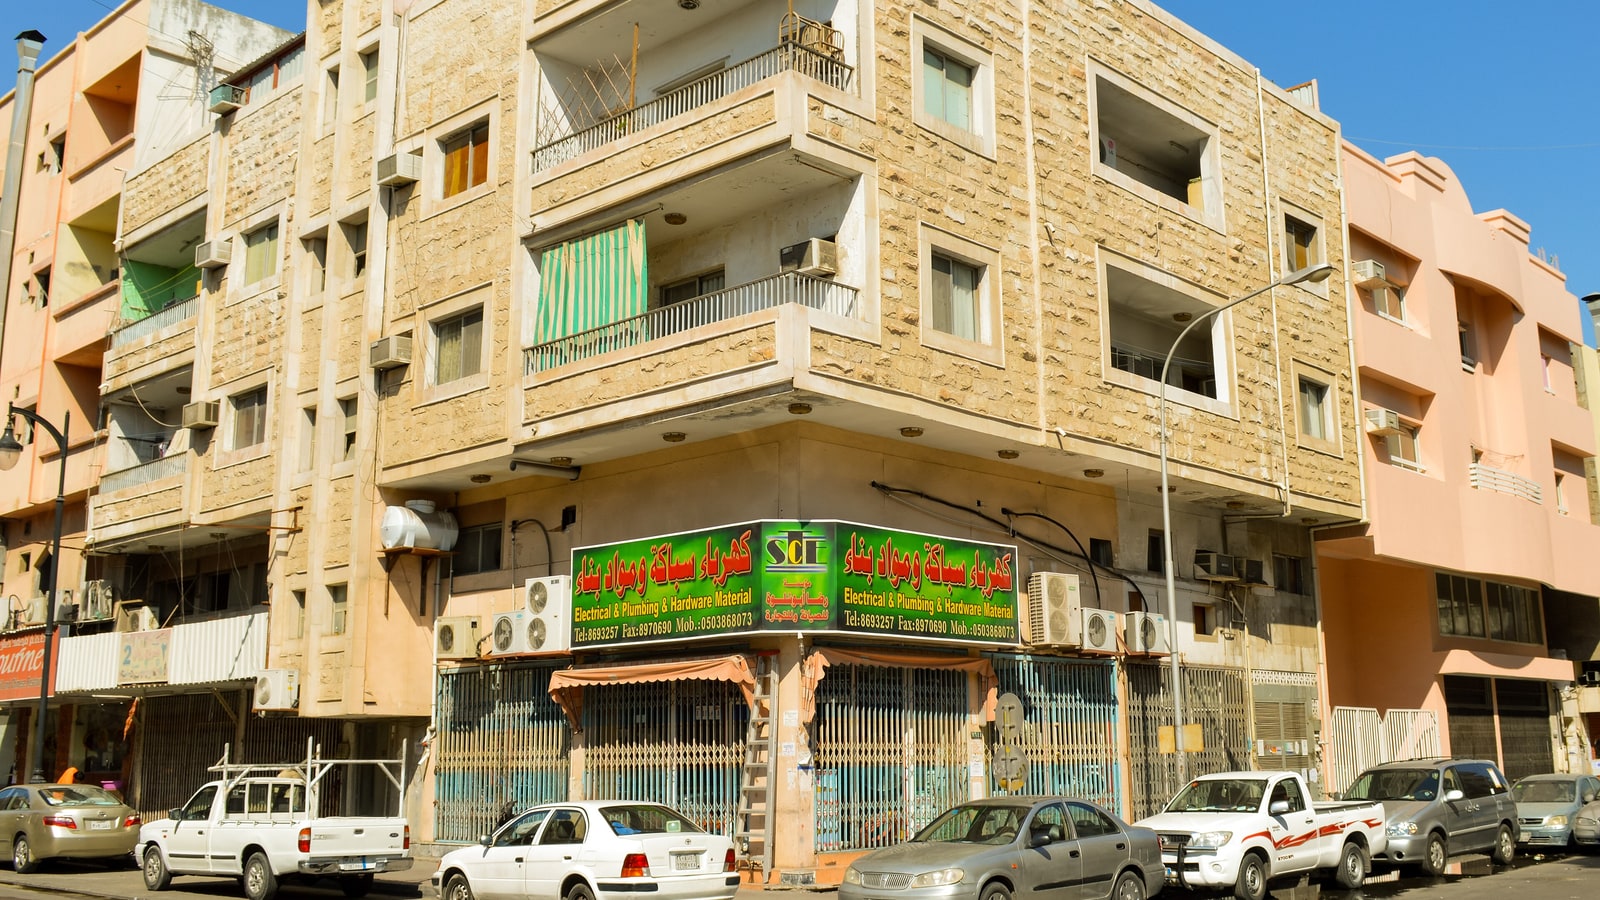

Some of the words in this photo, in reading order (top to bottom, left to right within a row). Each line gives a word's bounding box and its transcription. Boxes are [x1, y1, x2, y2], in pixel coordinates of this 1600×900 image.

[575, 555, 601, 601] بناء
[604, 550, 647, 599] ومواد
[649, 542, 695, 592] سباكة
[699, 530, 752, 587] كهرباء
[843, 531, 873, 586] بناء
[877, 537, 921, 591] ومواد
[924, 542, 966, 595] سباكة
[969, 549, 1013, 599] كهرباء
[574, 604, 611, 622] Electrical
[613, 602, 620, 618] &
[622, 600, 659, 618] Plumbing
[661, 597, 668, 613] &
[670, 594, 713, 612] Hardware
[715, 587, 752, 607] Material
[844, 587, 886, 607] Electrical
[888, 592, 895, 608] &
[897, 593, 935, 616] Plumbing
[936, 597, 943, 613] &
[944, 598, 982, 616] Hardware
[983, 602, 1013, 619] Material
[844, 610, 894, 629] Tel:8693257
[898, 615, 947, 634] Fax:8970690
[123, 644, 132, 665] 2
[574, 626, 619, 642] Tel:8693257
[622, 620, 672, 638] Fax:8970690
